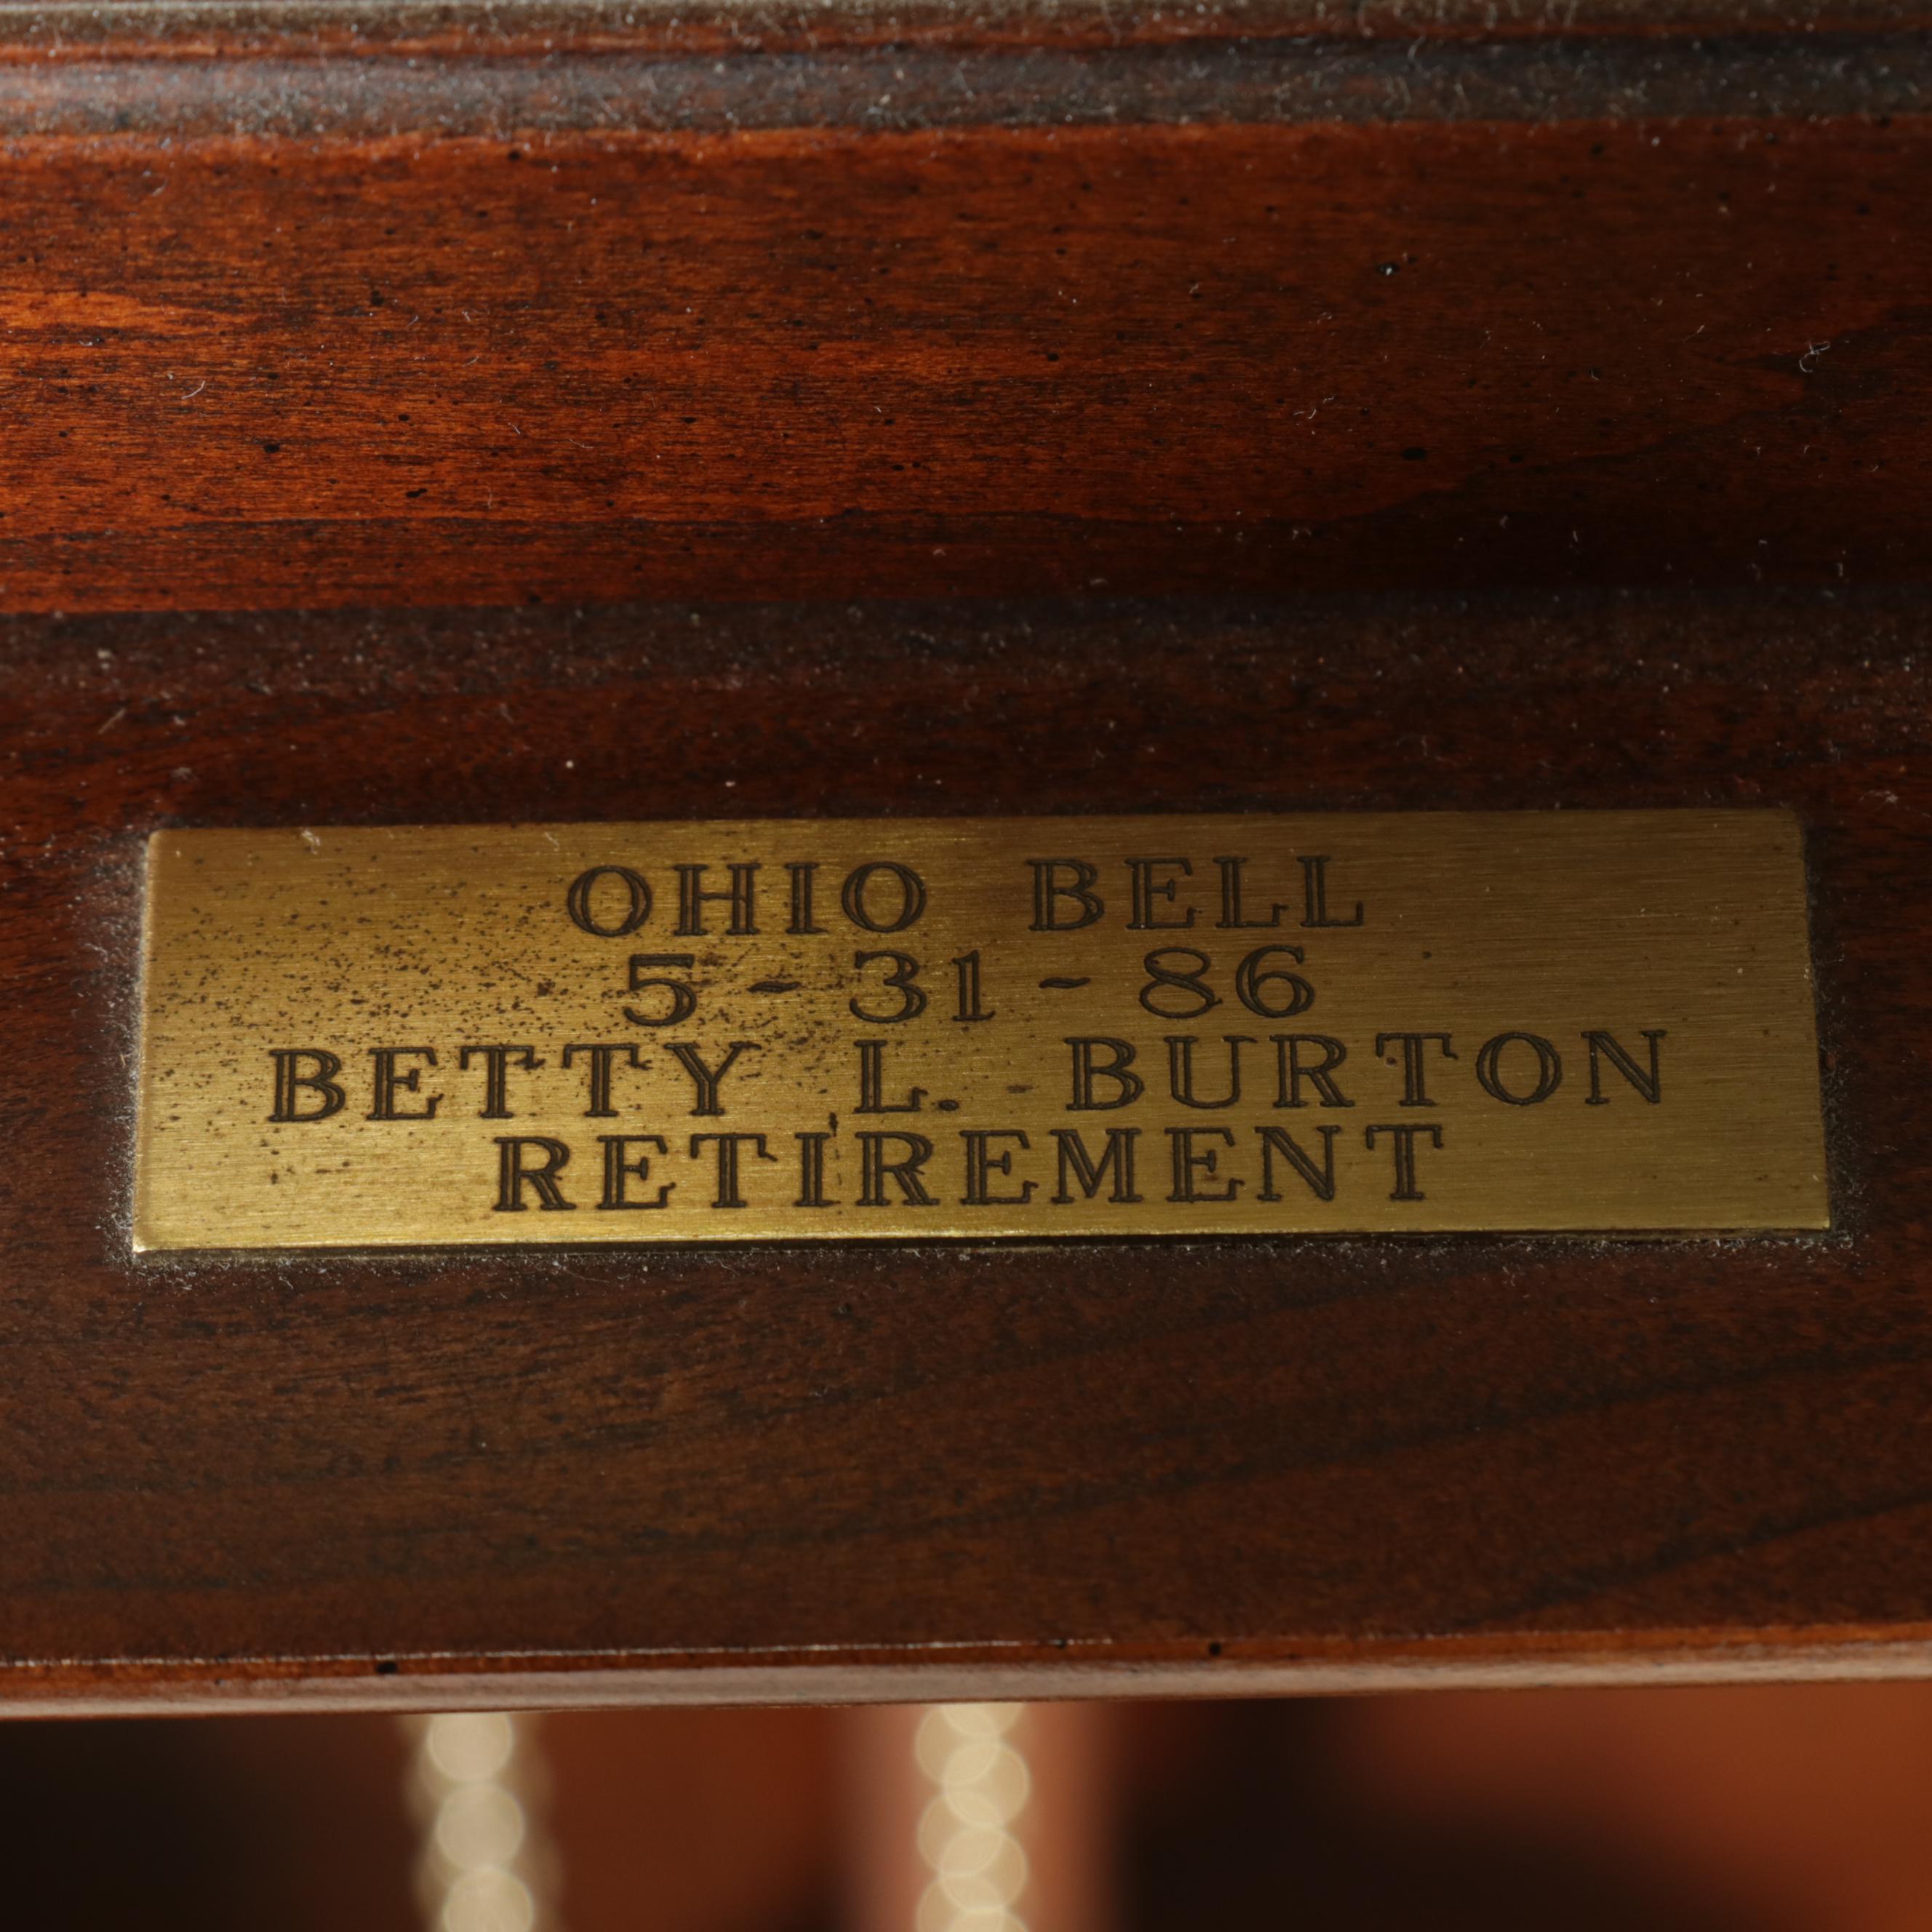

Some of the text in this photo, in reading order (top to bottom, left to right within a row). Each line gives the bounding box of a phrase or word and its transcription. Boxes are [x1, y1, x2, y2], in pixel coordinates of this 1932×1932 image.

[567, 855, 1364, 937] OHIO BELL
[268, 1029, 1667, 1122] BETTY L. BURTON
[492, 1124, 1444, 1212] RETIREMENT
